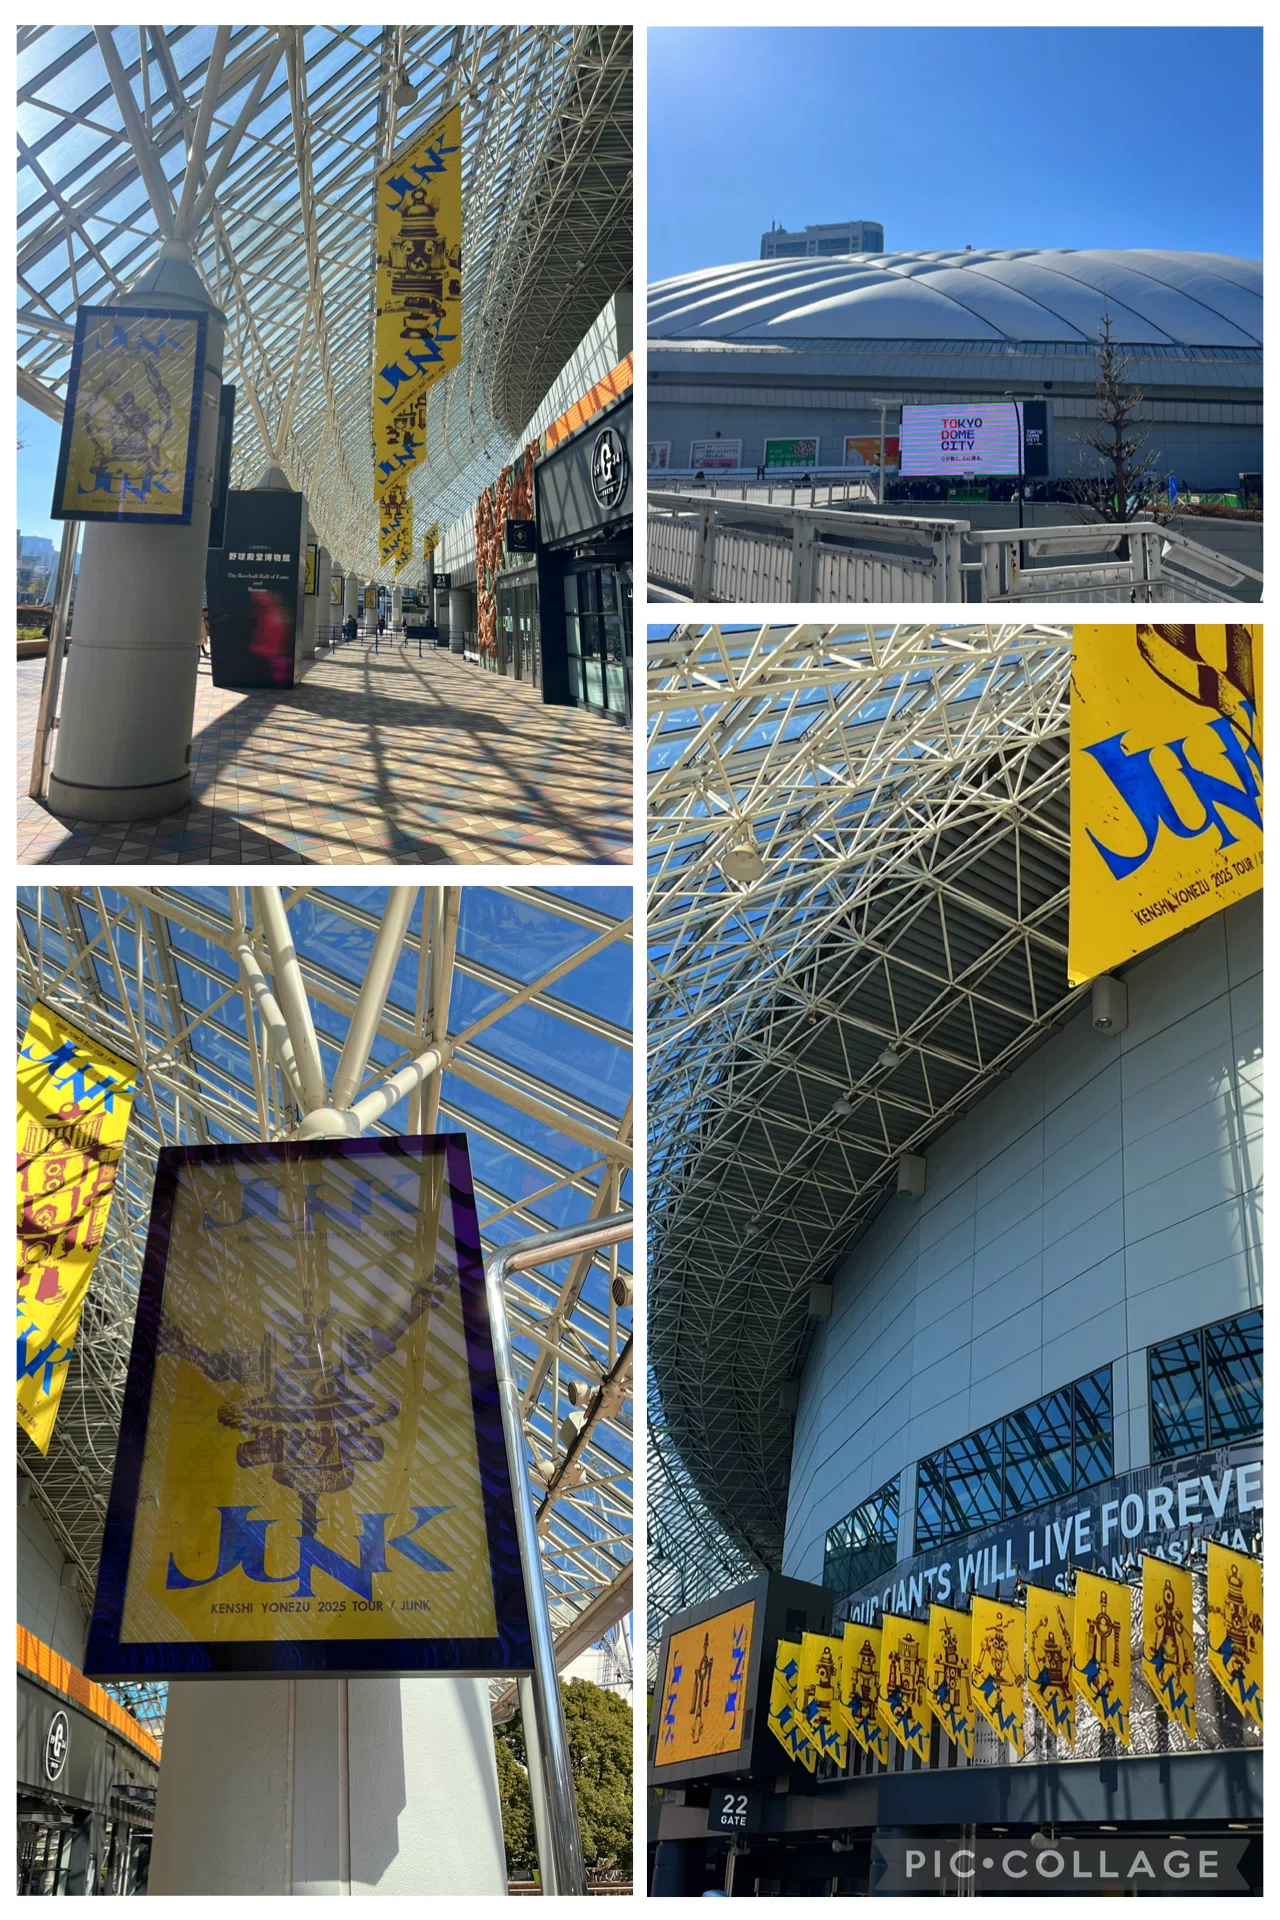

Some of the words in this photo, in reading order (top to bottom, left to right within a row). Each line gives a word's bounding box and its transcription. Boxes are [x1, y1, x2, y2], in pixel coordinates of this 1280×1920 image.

[384, 132, 460, 211] JUNK
[378, 317, 458, 405] JUNK
[941, 418, 983, 429] TOKYO
[941, 430, 975, 439] DOME
[378, 432, 424, 485] JUNK
[941, 441, 975, 451] CITY
[77, 468, 176, 502] JUNK
[229, 552, 291, 562] 野球殿堂博物館
[1134, 898, 1171, 926] KENSHI
[1172, 878, 1210, 906] YONEZU
[1211, 867, 1233, 888] 2025
[1234, 857, 1254, 877] TOUR
[20, 1040, 135, 1115] JUNK
[203, 1173, 426, 1233] JUNK
[166, 1505, 456, 1602] JUNK
[882, 1562, 951, 1613] GIANTS
[958, 1539, 1017, 1594] WILL
[1029, 1510, 1091, 1571] LIVE
[211, 1602, 254, 1614] KENSHI
[261, 1601, 310, 1613] YONEZU
[317, 1600, 346, 1612] 2025
[352, 1600, 384, 1612] TOUR
[400, 1599, 430, 1611] JUNK
[720, 1815, 746, 1826] GATE
[722, 1794, 748, 1815] 22
